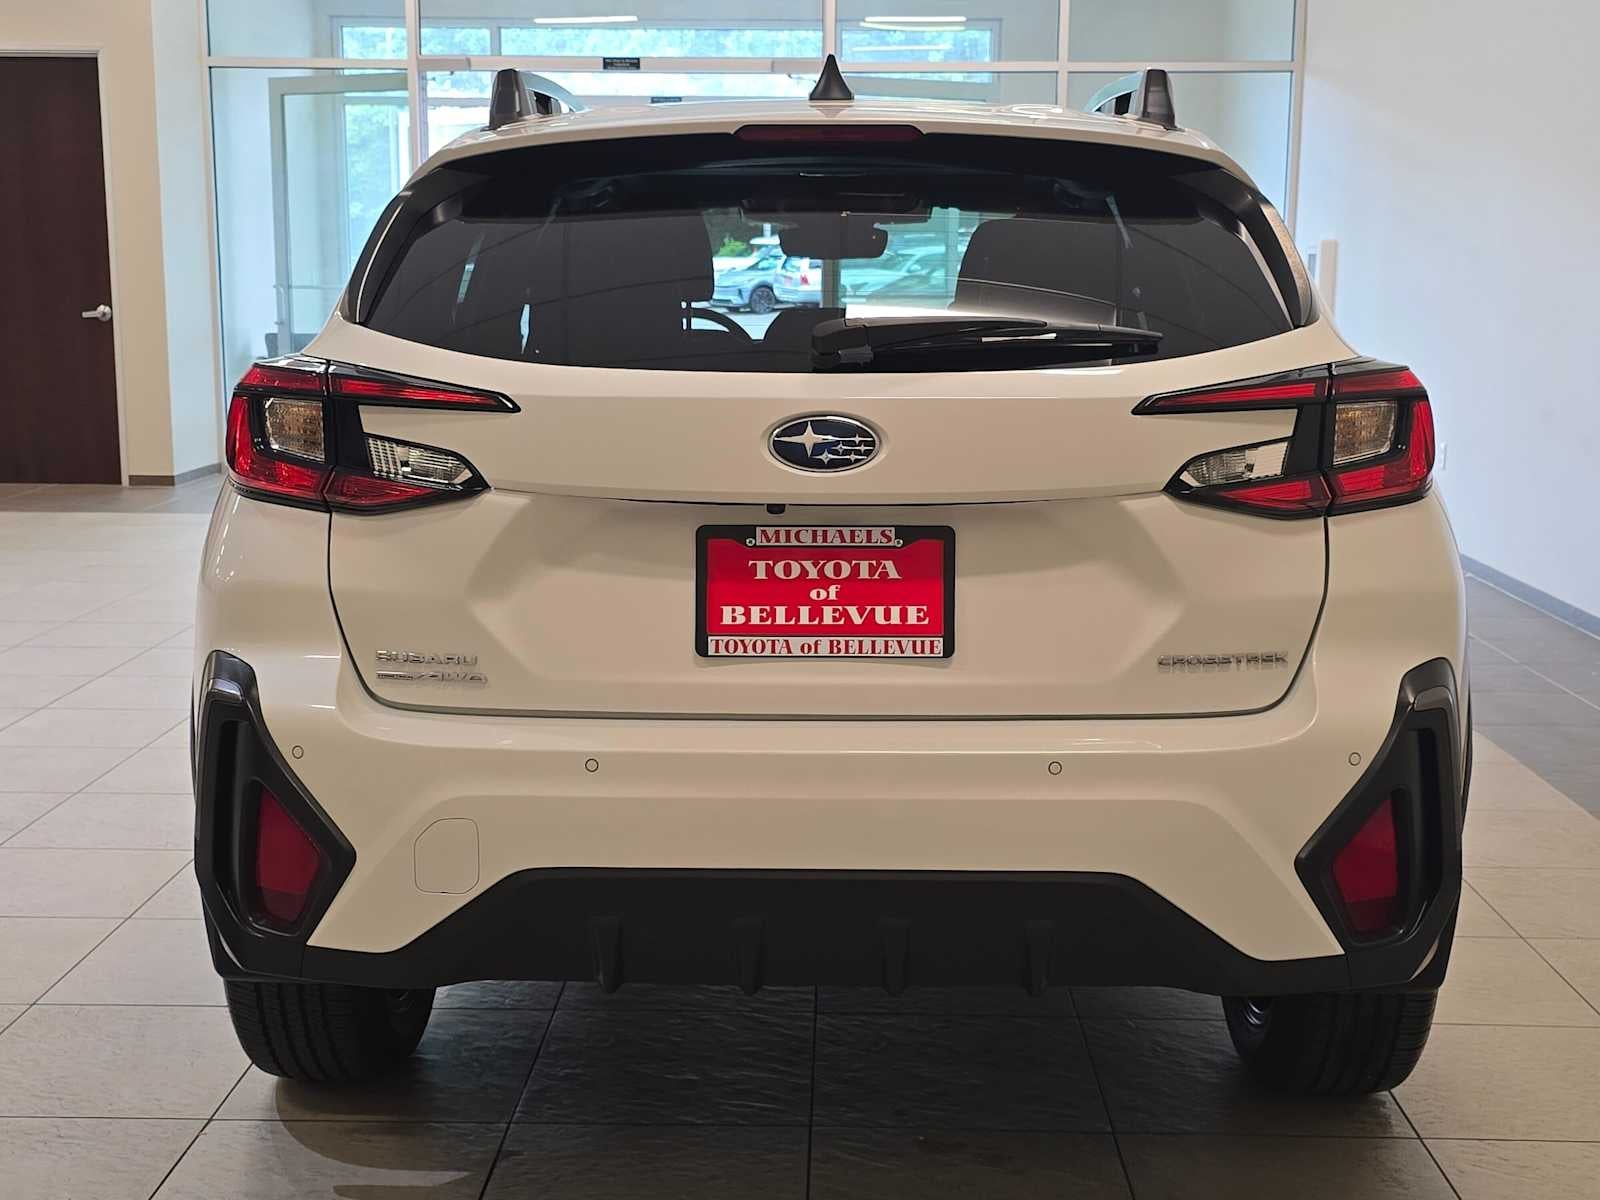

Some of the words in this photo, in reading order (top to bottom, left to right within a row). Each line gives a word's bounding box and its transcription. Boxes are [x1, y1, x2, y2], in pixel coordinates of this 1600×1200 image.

[759, 528, 893, 544] MICHAELS
[748, 560, 902, 580] TOYOTA
[809, 584, 841, 601] of
[720, 605, 929, 625] BELLEVUE
[710, 638, 793, 655] TOYOTA
[800, 639, 822, 655] of
[829, 639, 942, 655] BELLEVUE
[375, 649, 478, 666] SUBARU
[1157, 652, 1288, 670] CROSSTREK
